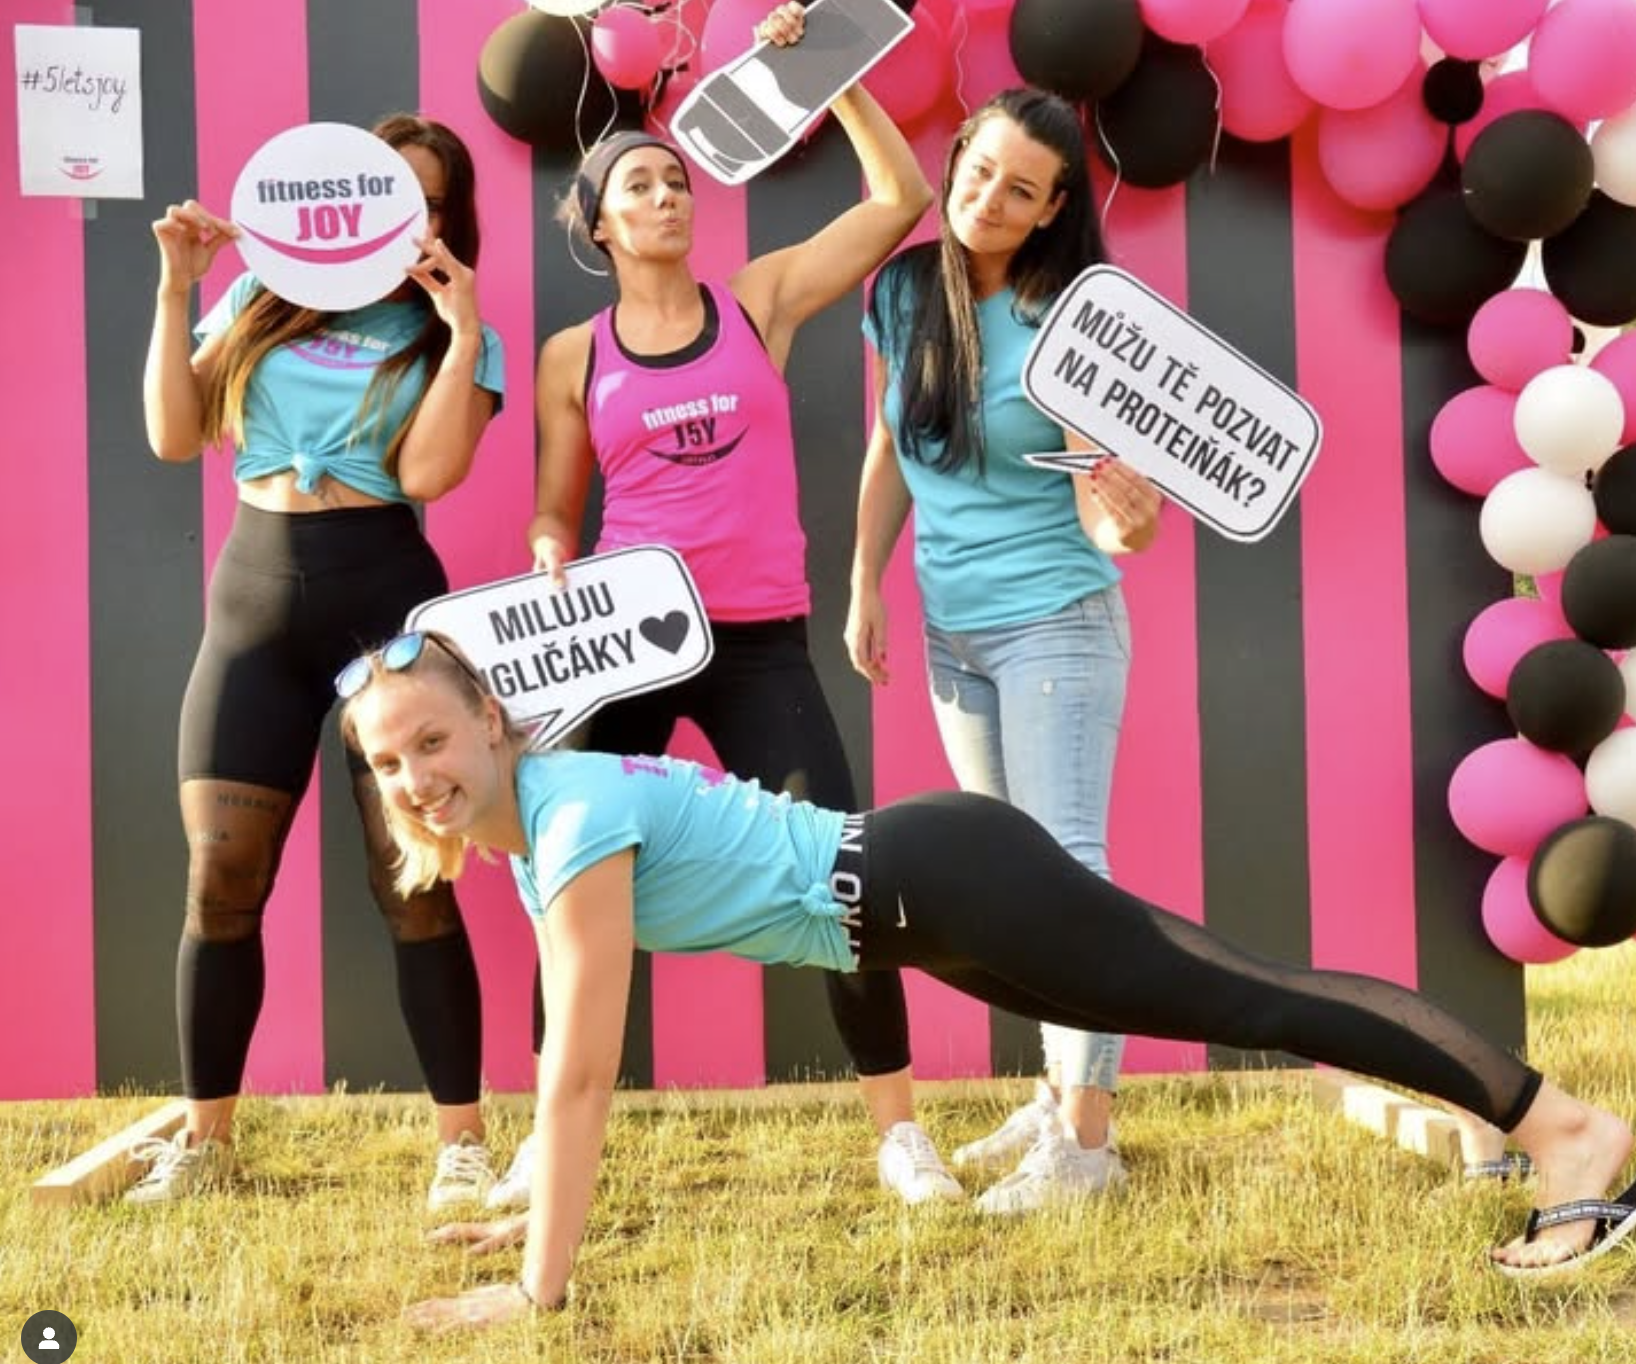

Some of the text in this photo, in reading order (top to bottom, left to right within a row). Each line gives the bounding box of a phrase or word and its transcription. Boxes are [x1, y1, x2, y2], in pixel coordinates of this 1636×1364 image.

[256, 173, 395, 203] fitness for
[296, 203, 363, 242] JOY
[642, 393, 738, 430] fitness for
[1071, 300, 1299, 472] MŮŽU TĚ POZVAT
[1054, 347, 1266, 508] NA PROTEIŇÁK?
[489, 581, 615, 645] MILUJU
[480, 628, 635, 699] GLIČÁKY
